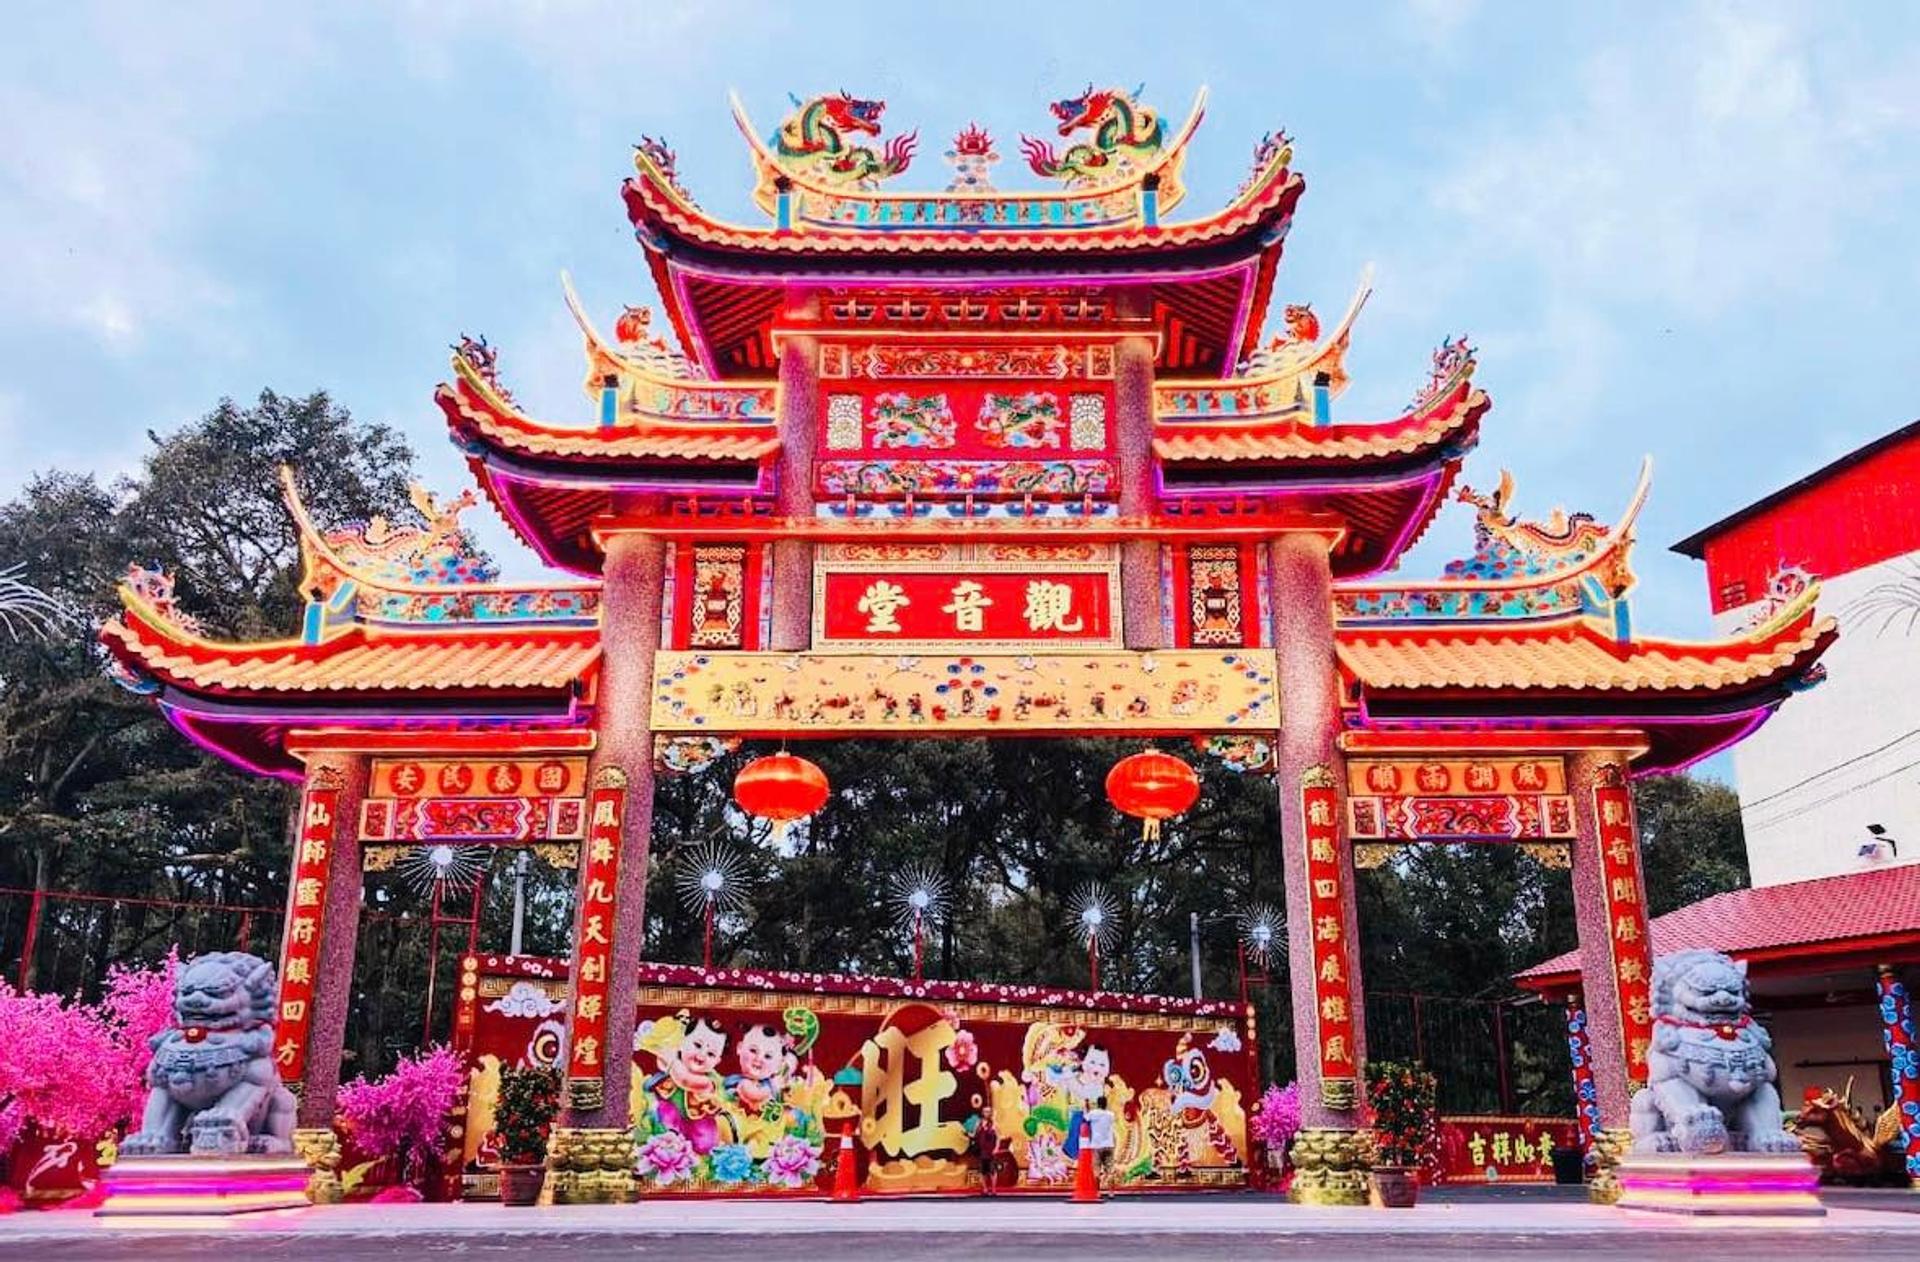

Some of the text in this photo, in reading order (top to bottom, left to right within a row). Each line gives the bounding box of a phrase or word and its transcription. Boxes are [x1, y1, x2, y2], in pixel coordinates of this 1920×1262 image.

[857, 579, 1083, 634] 觀音堂
[396, 764, 564, 791] 國泰民安
[1371, 761, 1544, 791] 風調雨順
[573, 800, 619, 1066] 鳳舞九天創輝煌
[1308, 801, 1354, 1064] 龍騰四海展雄風
[861, 1019, 970, 1157] 旺
[1468, 1131, 1555, 1167] 吉祥如意
